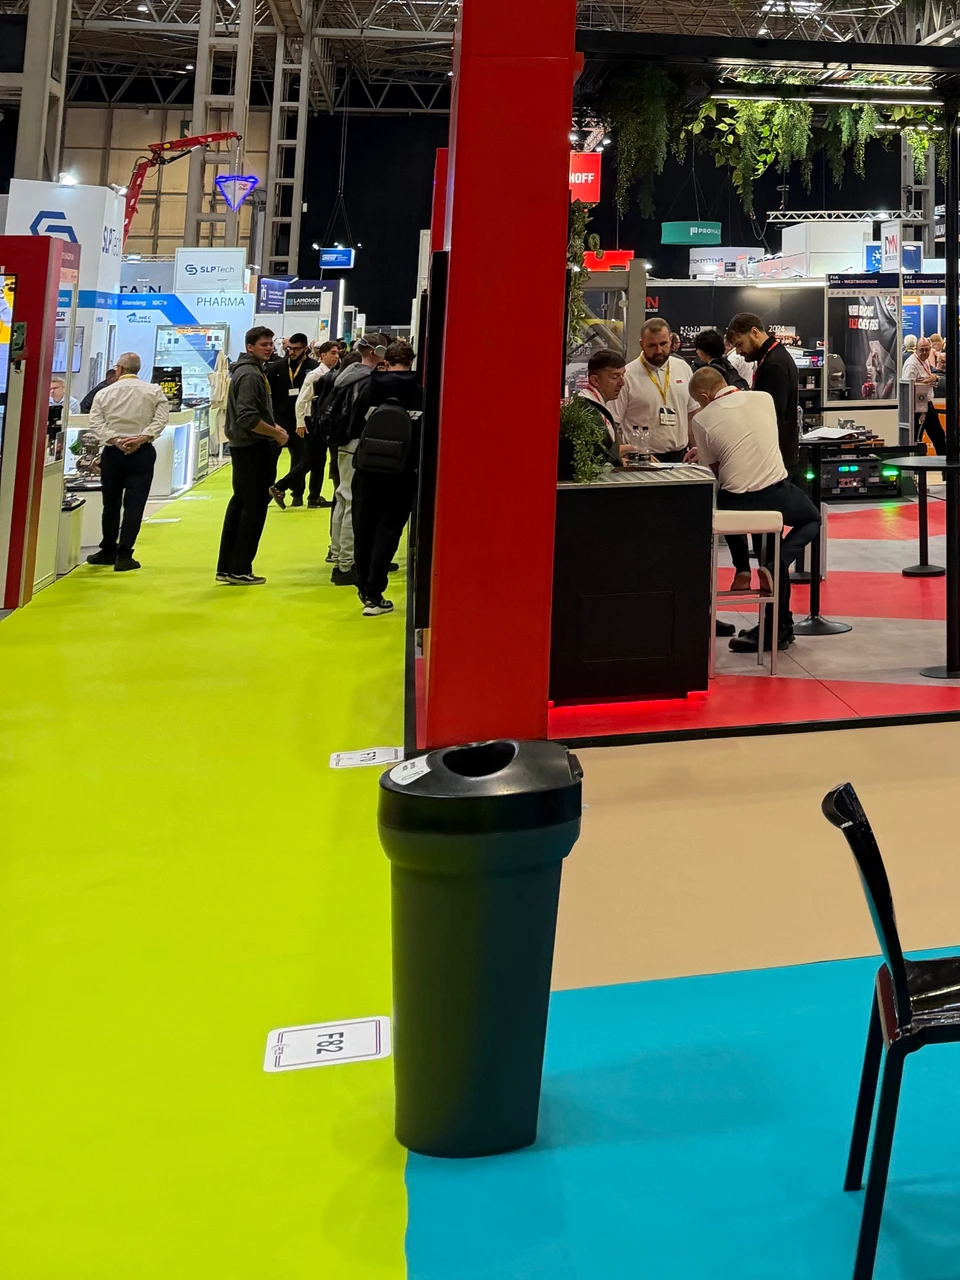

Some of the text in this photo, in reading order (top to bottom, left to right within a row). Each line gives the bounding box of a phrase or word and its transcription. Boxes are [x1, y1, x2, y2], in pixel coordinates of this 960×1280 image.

[569, 172, 595, 184] HOFF
[200, 265, 235, 274] SLPTech
[196, 297, 246, 307] PHARMA
[768, 324, 785, 333] 2024
[315, 1031, 345, 1055] F82
